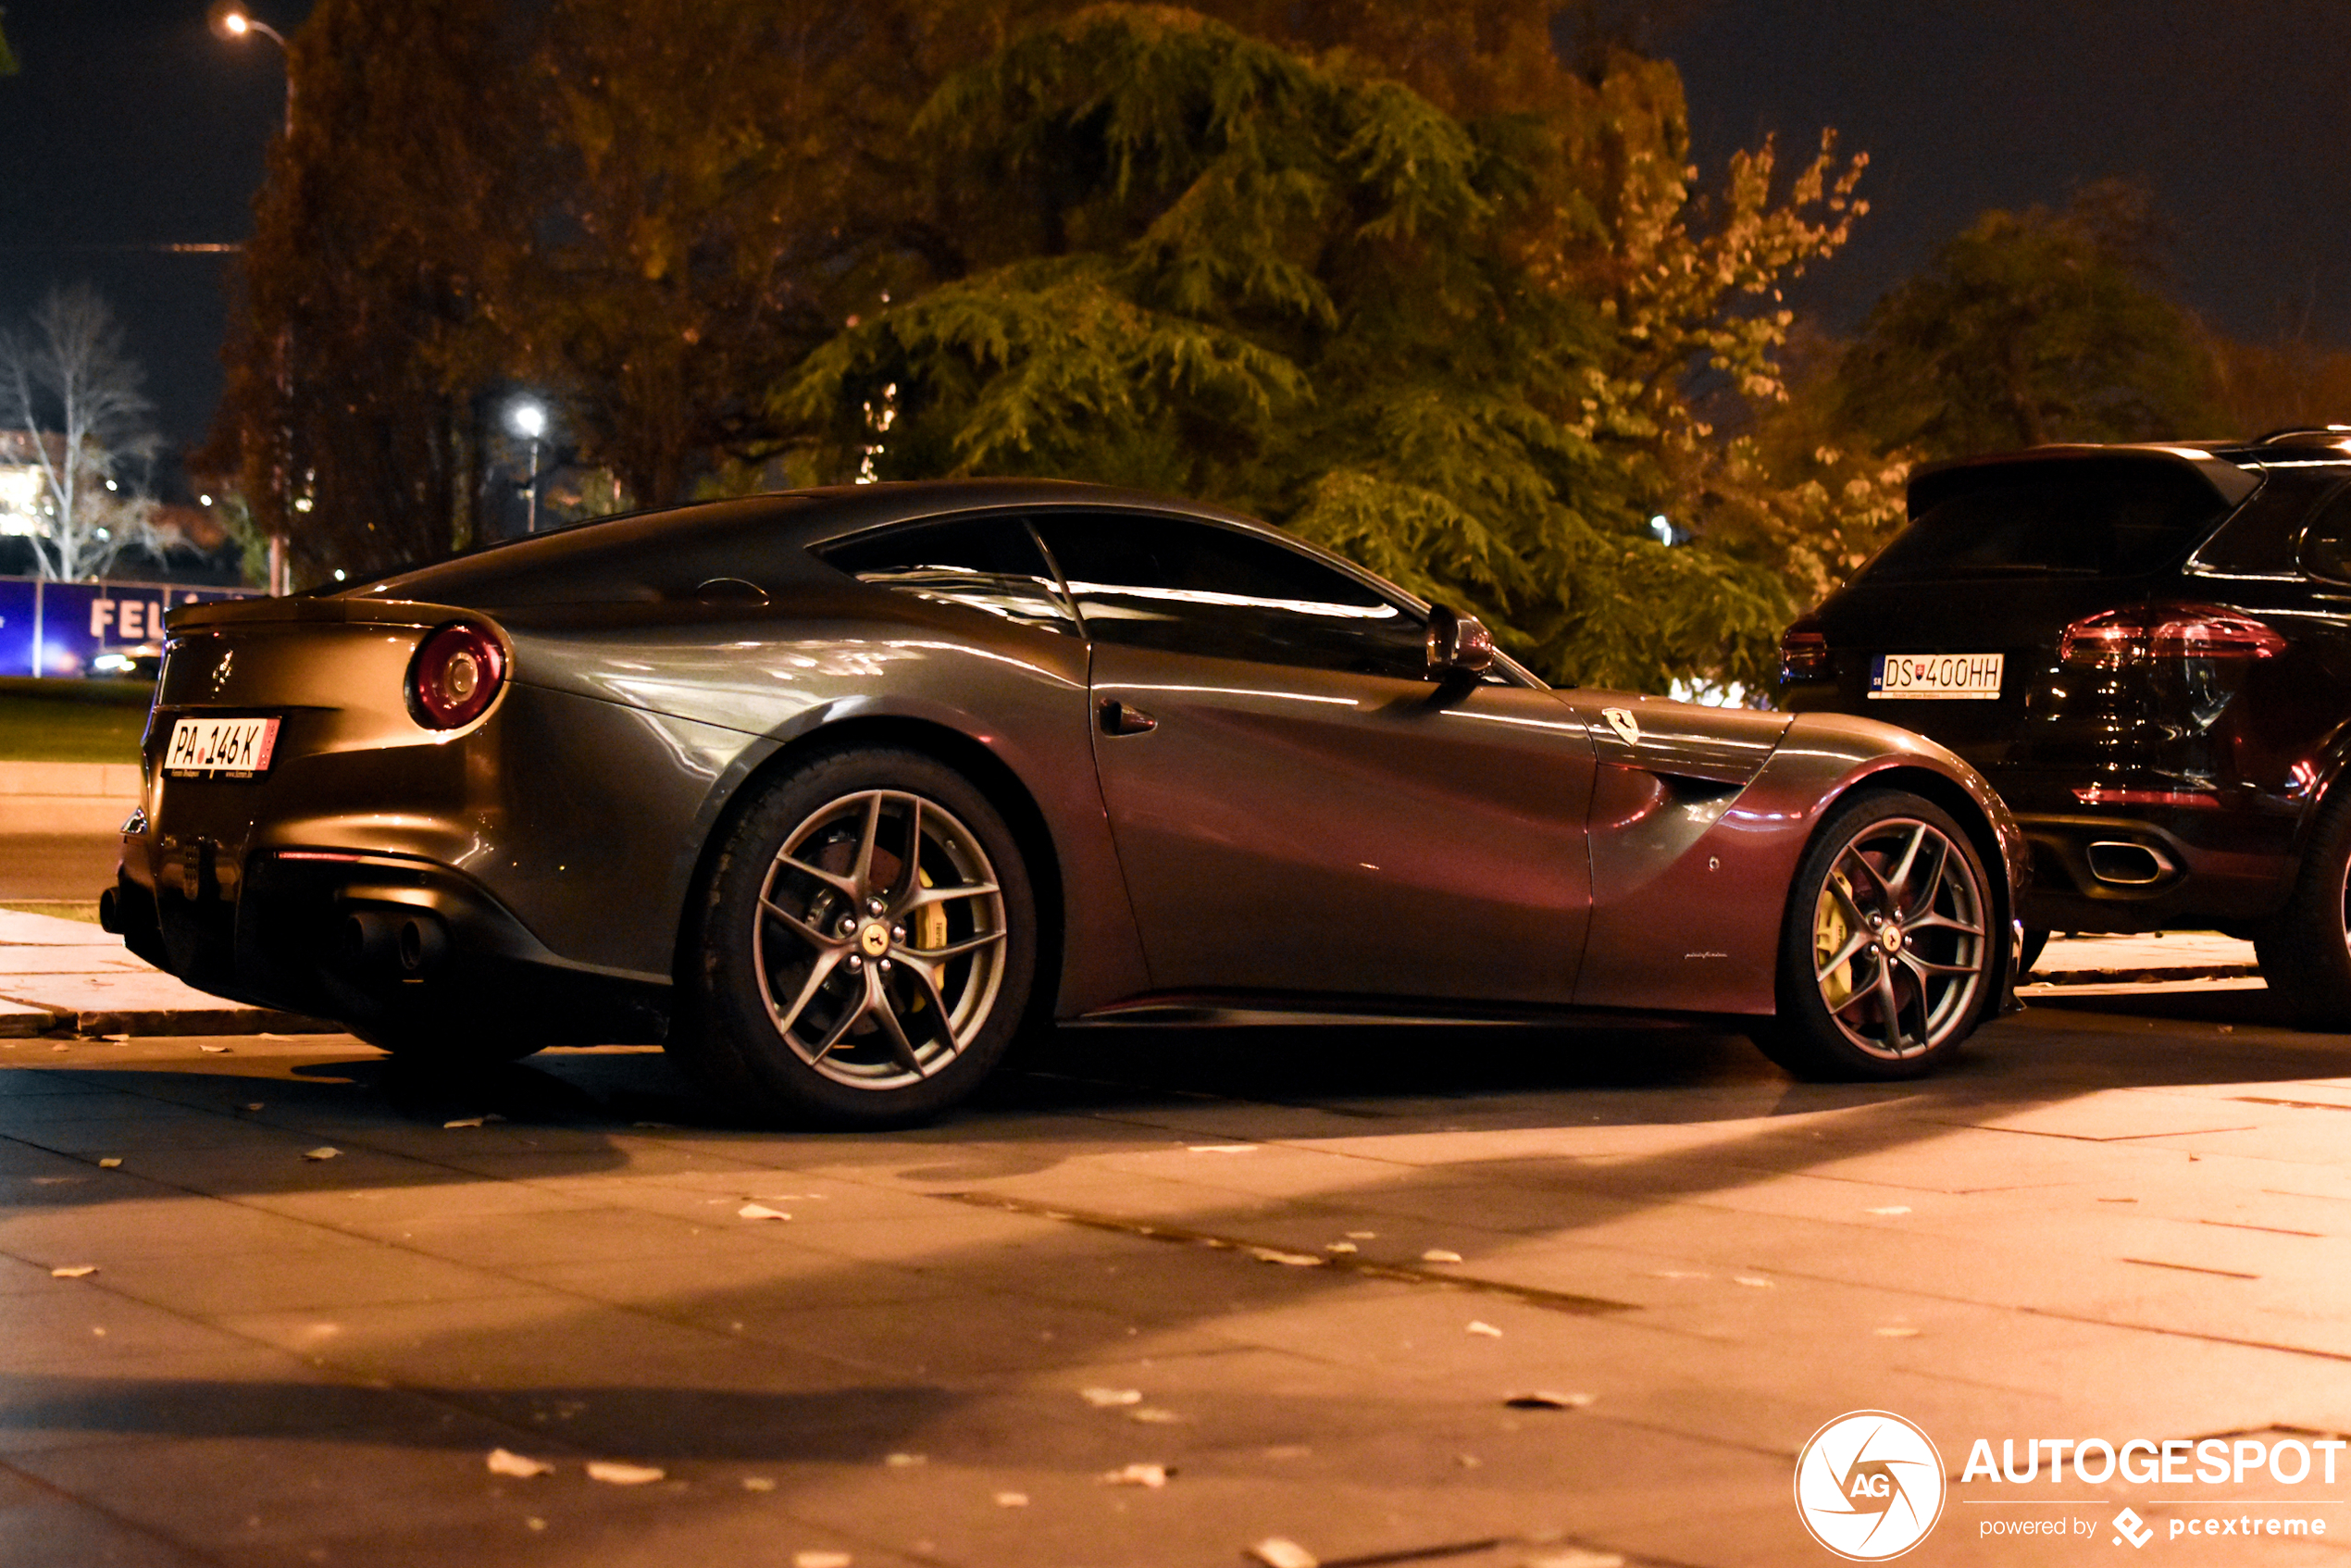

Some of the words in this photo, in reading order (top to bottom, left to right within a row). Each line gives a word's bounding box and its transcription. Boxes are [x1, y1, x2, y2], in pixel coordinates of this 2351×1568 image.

[90, 599, 165, 639] FEL
[1885, 659, 1913, 687] DS
[1926, 658, 1998, 687] 400HH
